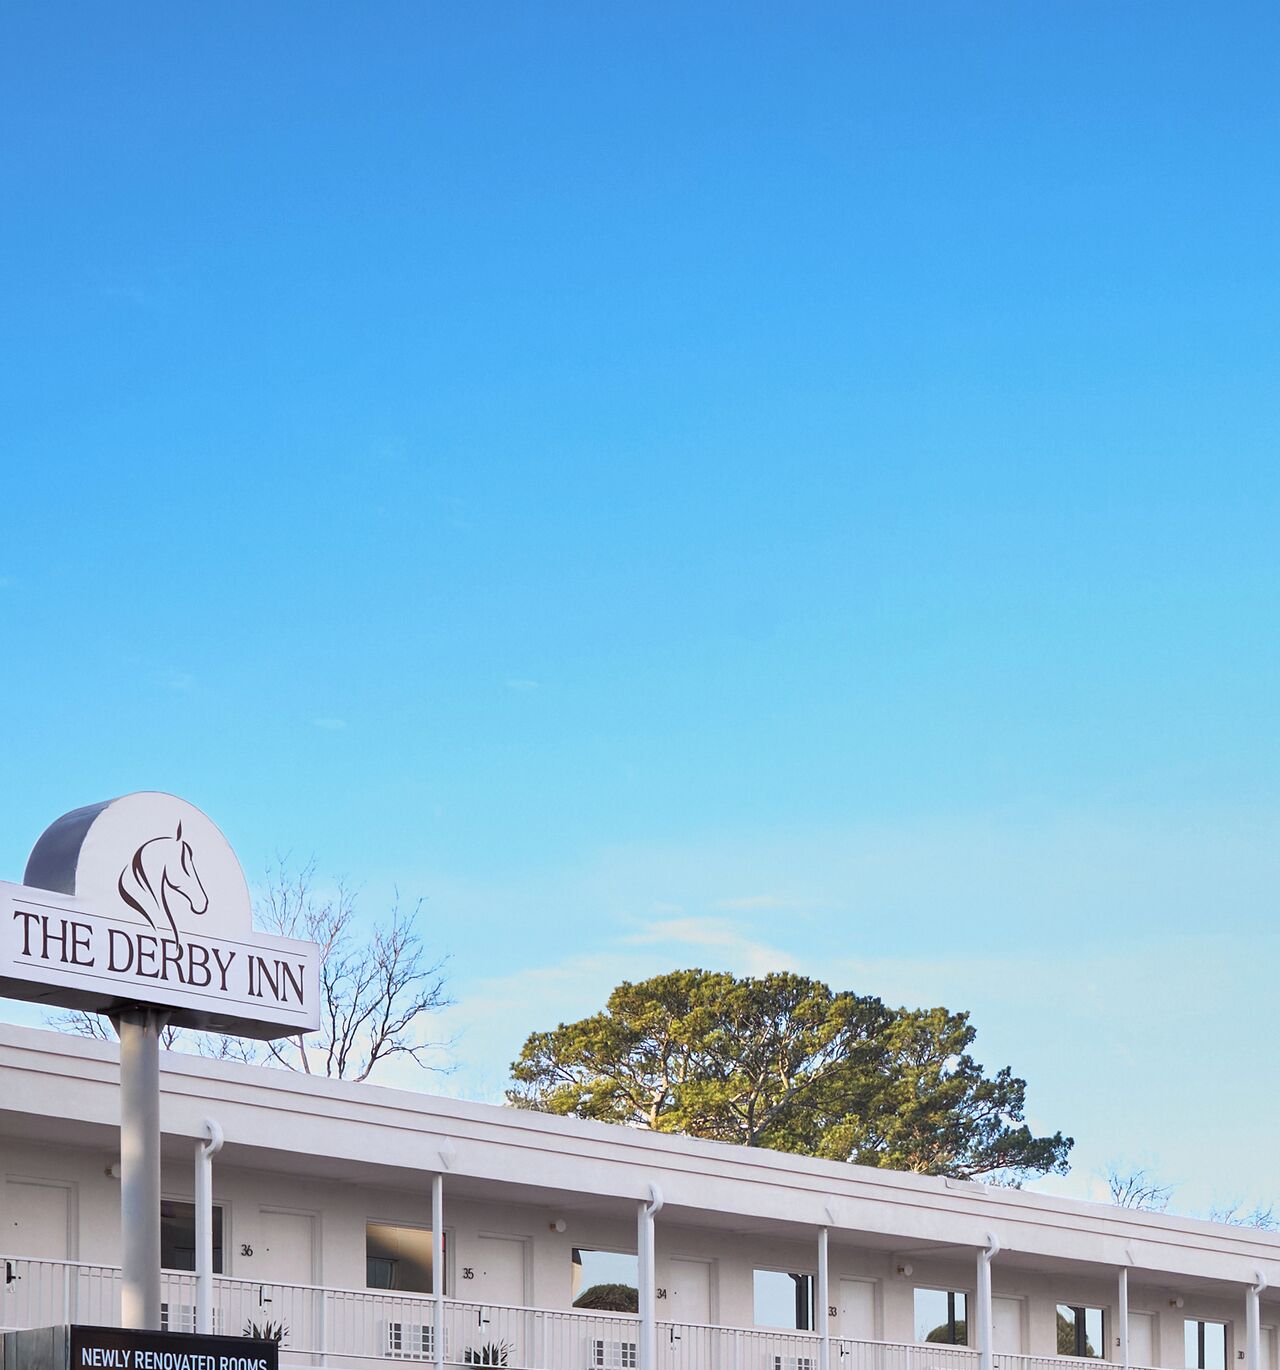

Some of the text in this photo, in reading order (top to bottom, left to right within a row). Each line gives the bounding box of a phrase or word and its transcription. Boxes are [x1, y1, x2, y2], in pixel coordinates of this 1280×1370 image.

[13, 910, 305, 1006] THE DERBY INN
[241, 1244, 253, 1256] 36
[463, 1267, 474, 1279] 35
[657, 1288, 667, 1299] 34
[82, 1347, 131, 1368] NEWLY
